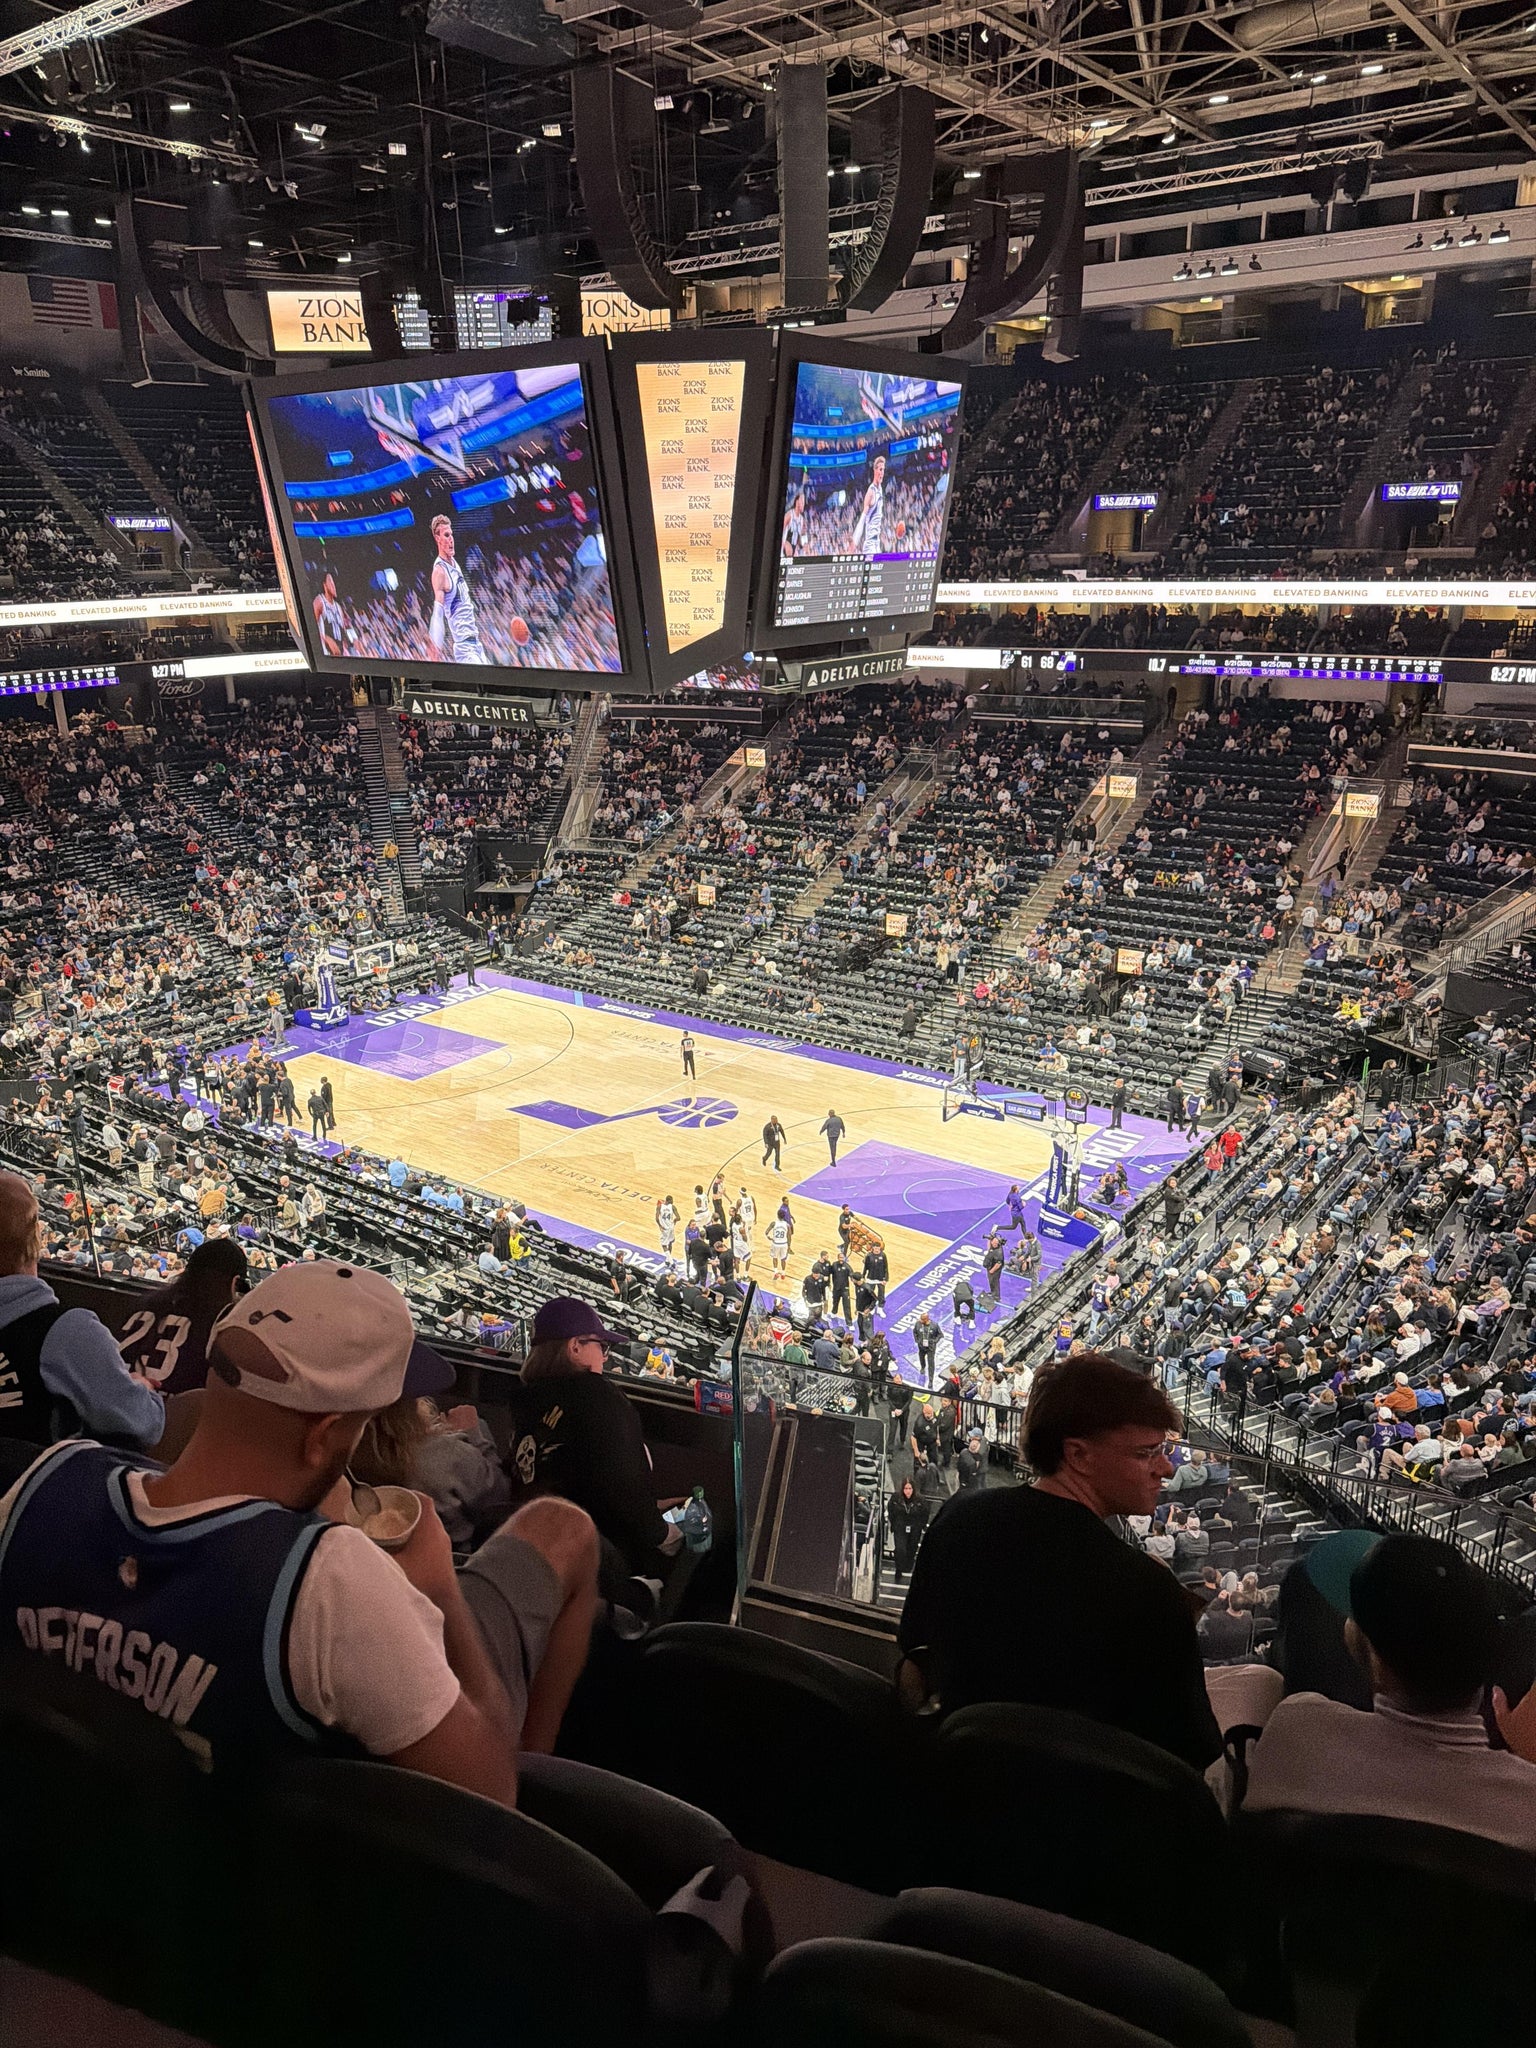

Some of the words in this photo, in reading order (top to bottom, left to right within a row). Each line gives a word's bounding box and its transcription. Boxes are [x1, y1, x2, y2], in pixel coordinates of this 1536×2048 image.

[298, 299, 361, 318] ZION
[584, 299, 640, 318] IONS
[711, 396, 734, 404] ZIONS
[1388, 486, 1406, 497] SAS
[1441, 484, 1458, 495] UTA
[1100, 497, 1115, 507] SAS
[1141, 495, 1156, 505] UTA
[116, 519, 131, 528] SAS
[155, 518, 170, 528] UTA
[983, 589, 1022, 597] ELEVATED
[1023, 589, 1059, 597] BANKING
[1072, 588, 1114, 596] ELEVATED
[1115, 588, 1154, 596] BANKING
[1168, 588, 1213, 597] ELEVATED
[1215, 588, 1257, 597] BANKING
[1273, 588, 1322, 597] ELEVATED
[1323, 588, 1368, 597] BANKING
[1386, 589, 1440, 598] ELEVATED
[1441, 589, 1489, 598] BANKING
[1508, 590, 1536, 599] ELEV
[160, 602, 198, 611] ELEVATED
[199, 600, 233, 609] BANKING
[245, 598, 284, 607] ELEVATED
[18, 609, 57, 619] BANKING
[70, 606, 111, 616] ELEVATED
[112, 604, 148, 614] BANKING
[254, 658, 292, 667] ELEVATED
[911, 654, 945, 662] BANKING
[1021, 655, 1032, 668] 61
[1040, 656, 1054, 669] 68
[170, 663, 184, 677] PM
[821, 665, 859, 683] DELTA
[862, 657, 903, 676] CENTER
[1491, 667, 1515, 682] 8:27
[1518, 668, 1536, 683] PM
[157, 678, 195, 697] Ford
[424, 701, 471, 717] DELTA
[474, 704, 529, 722] CENTER
[366, 1003, 440, 1027] UTAH
[538, 1162, 597, 1184] CENTER
[600, 1181, 653, 1202] DELTA
[914, 1258, 962, 1290] Health
[889, 1264, 982, 1335] Intermountain
[118, 1310, 192, 1382] 23
